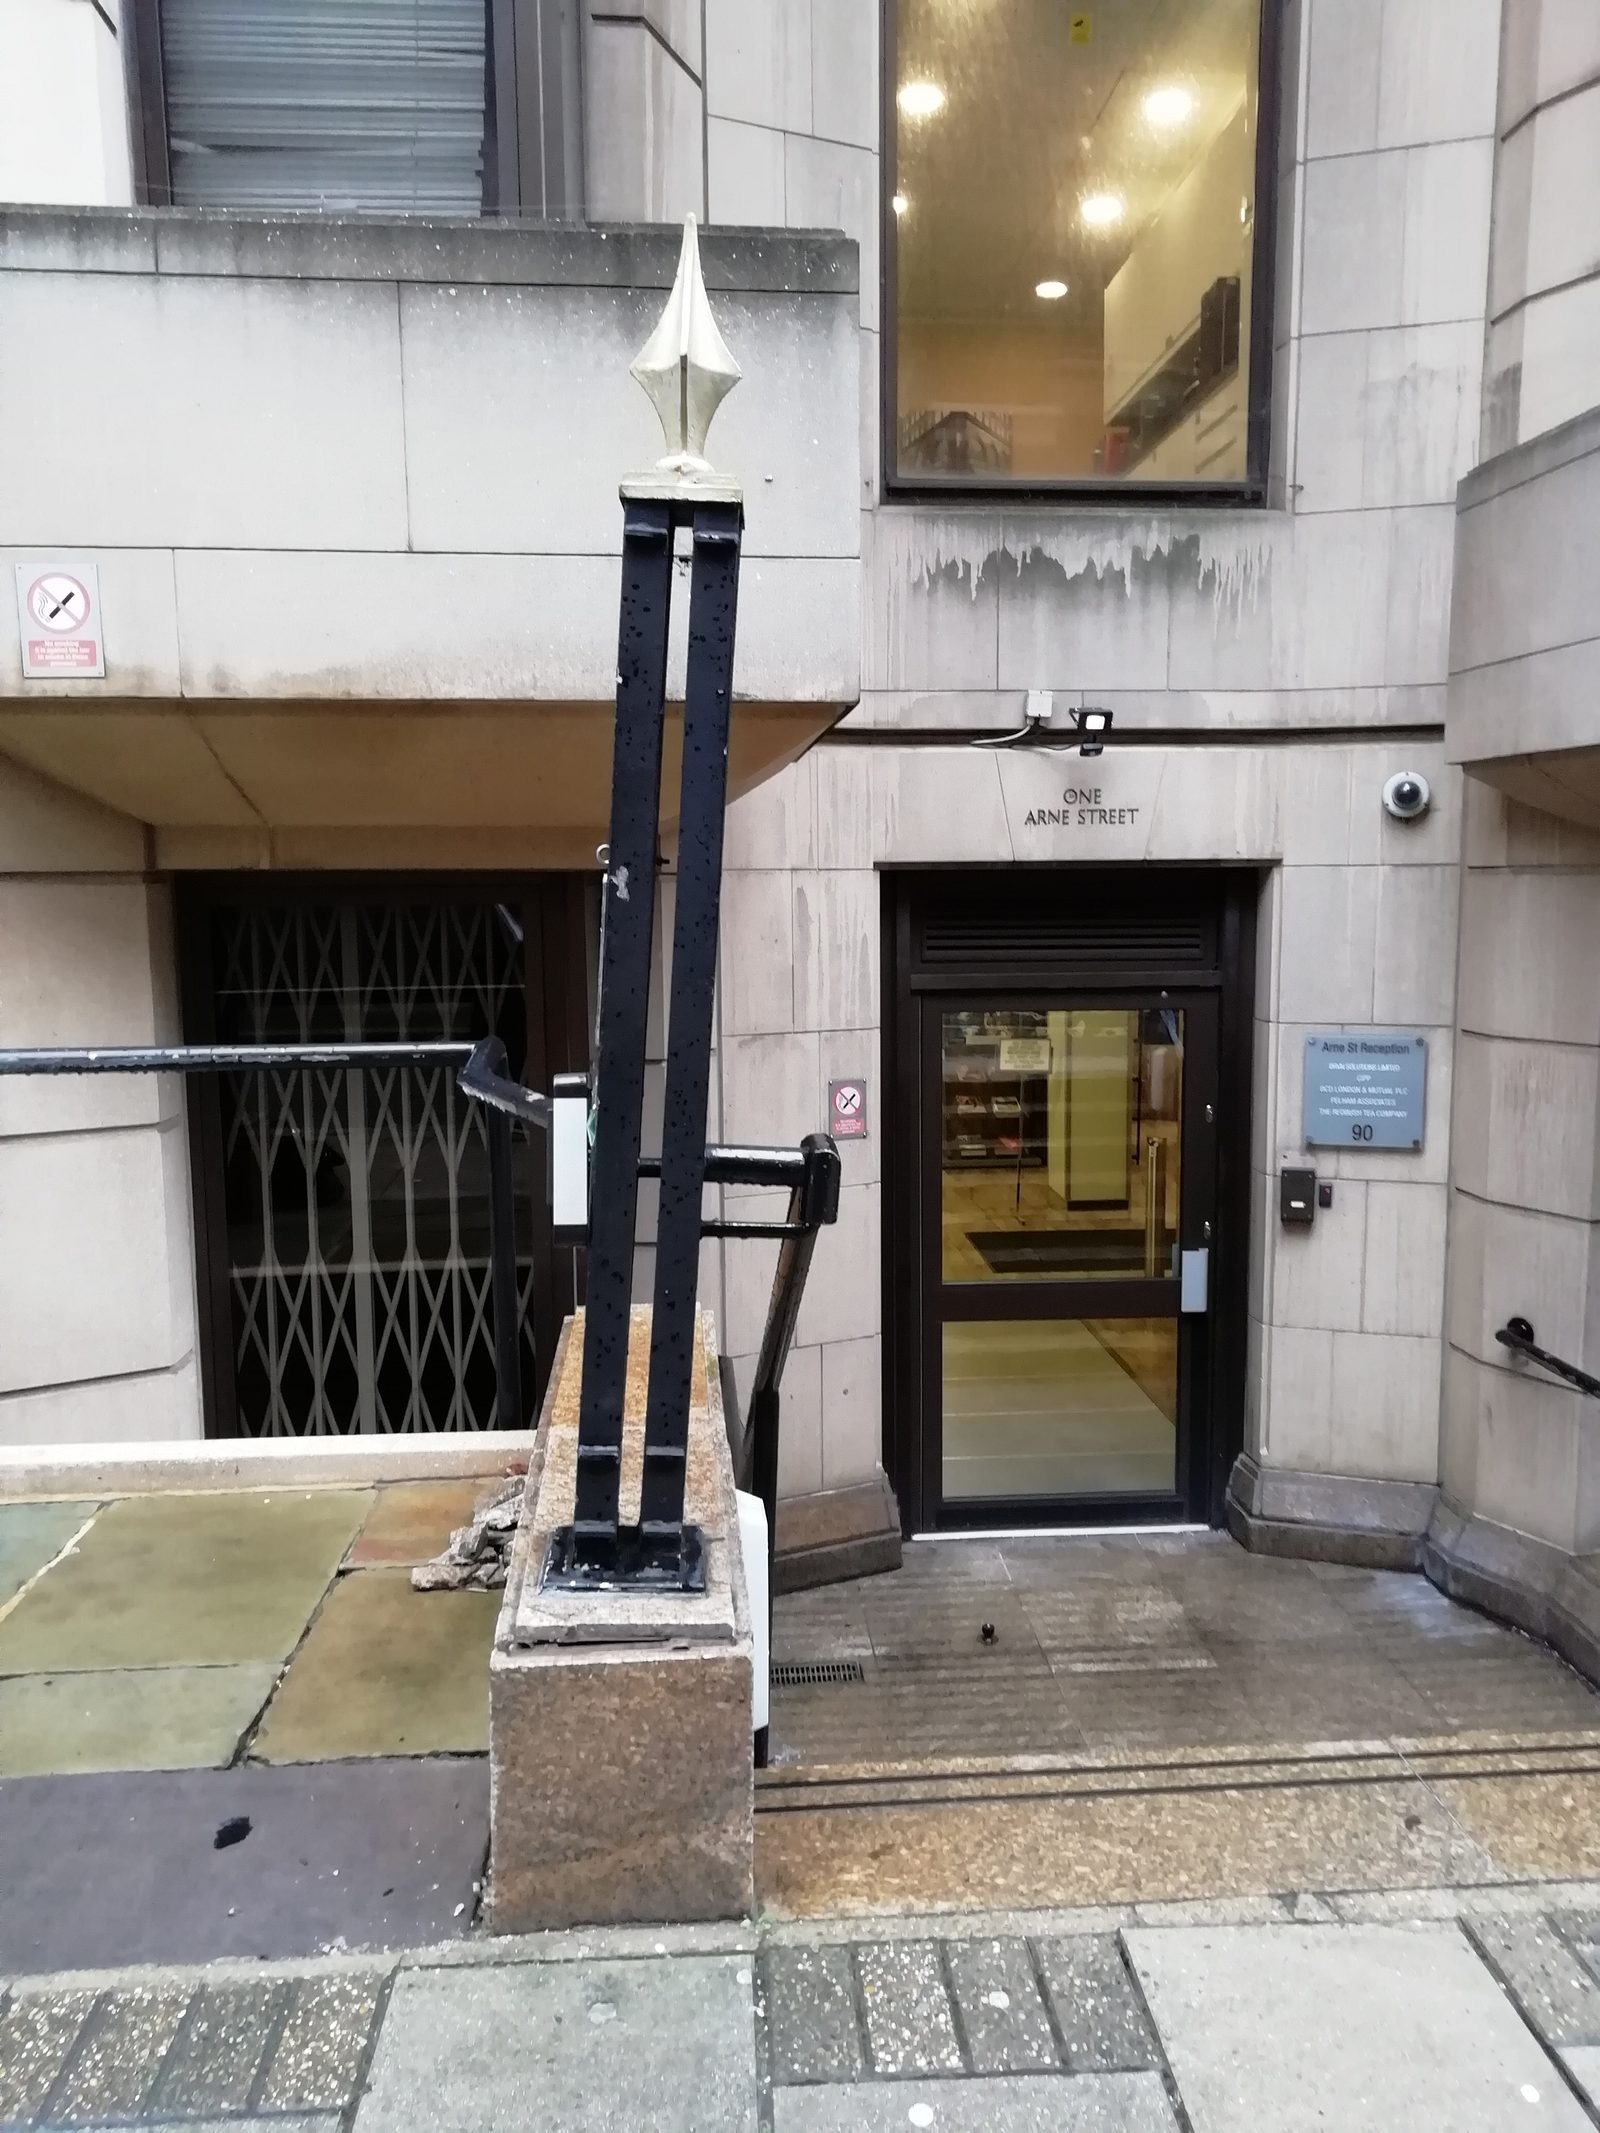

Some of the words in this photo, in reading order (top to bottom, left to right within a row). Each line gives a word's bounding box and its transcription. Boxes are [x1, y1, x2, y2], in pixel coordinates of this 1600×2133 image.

[1063, 788, 1102, 805] ONE
[1024, 809, 1070, 826] ARNE
[1078, 808, 1139, 825] STREET
[1321, 1042, 1345, 1053] Arne
[1347, 1042, 1358, 1053] St
[1360, 1043, 1410, 1055] Reception
[1351, 1124, 1374, 1142] 90
